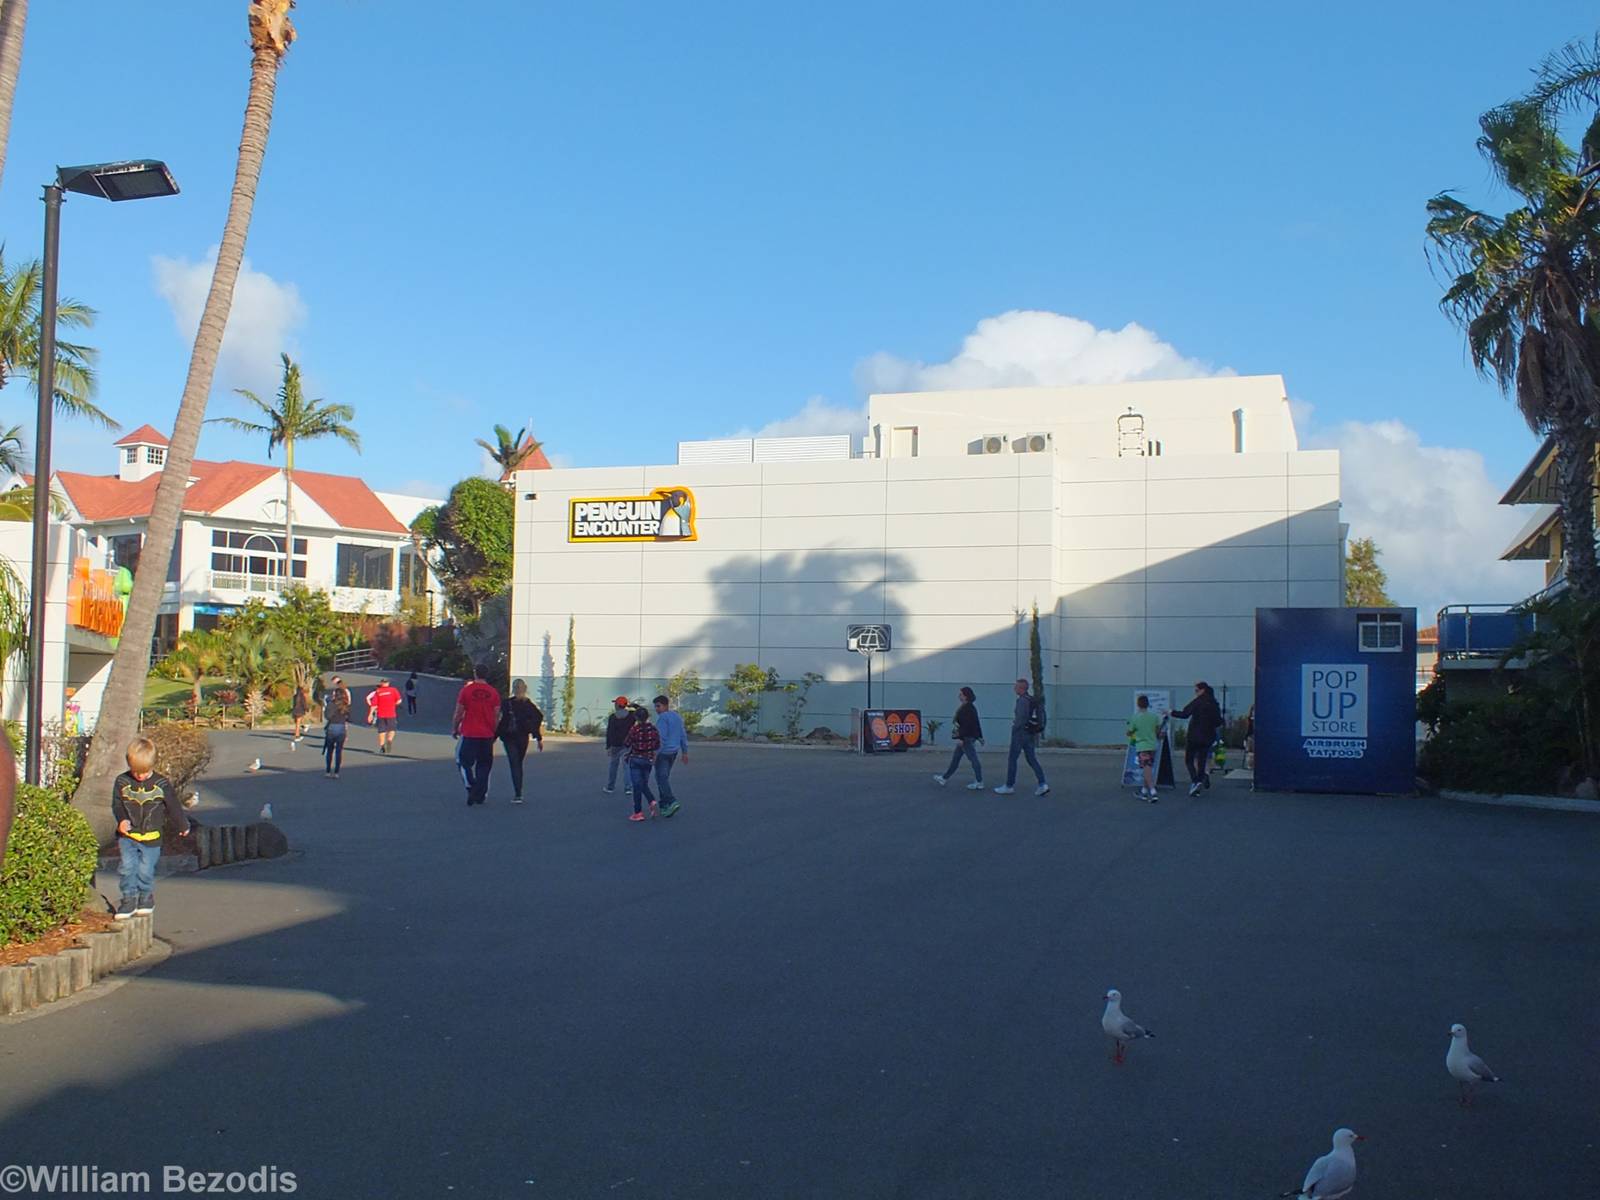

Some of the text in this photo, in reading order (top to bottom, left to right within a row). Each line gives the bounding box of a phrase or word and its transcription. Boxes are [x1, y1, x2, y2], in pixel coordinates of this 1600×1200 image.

[575, 501, 661, 521] PENGUIN
[575, 521, 660, 536] ENCOUNTER
[1312, 670, 1357, 689] POP
[1312, 692, 1357, 720] UP
[894, 723, 916, 734] SHOT
[1311, 721, 1357, 733] STORE
[1304, 740, 1366, 748] AIRBRUSH
[1309, 749, 1362, 757] TATTOOS
